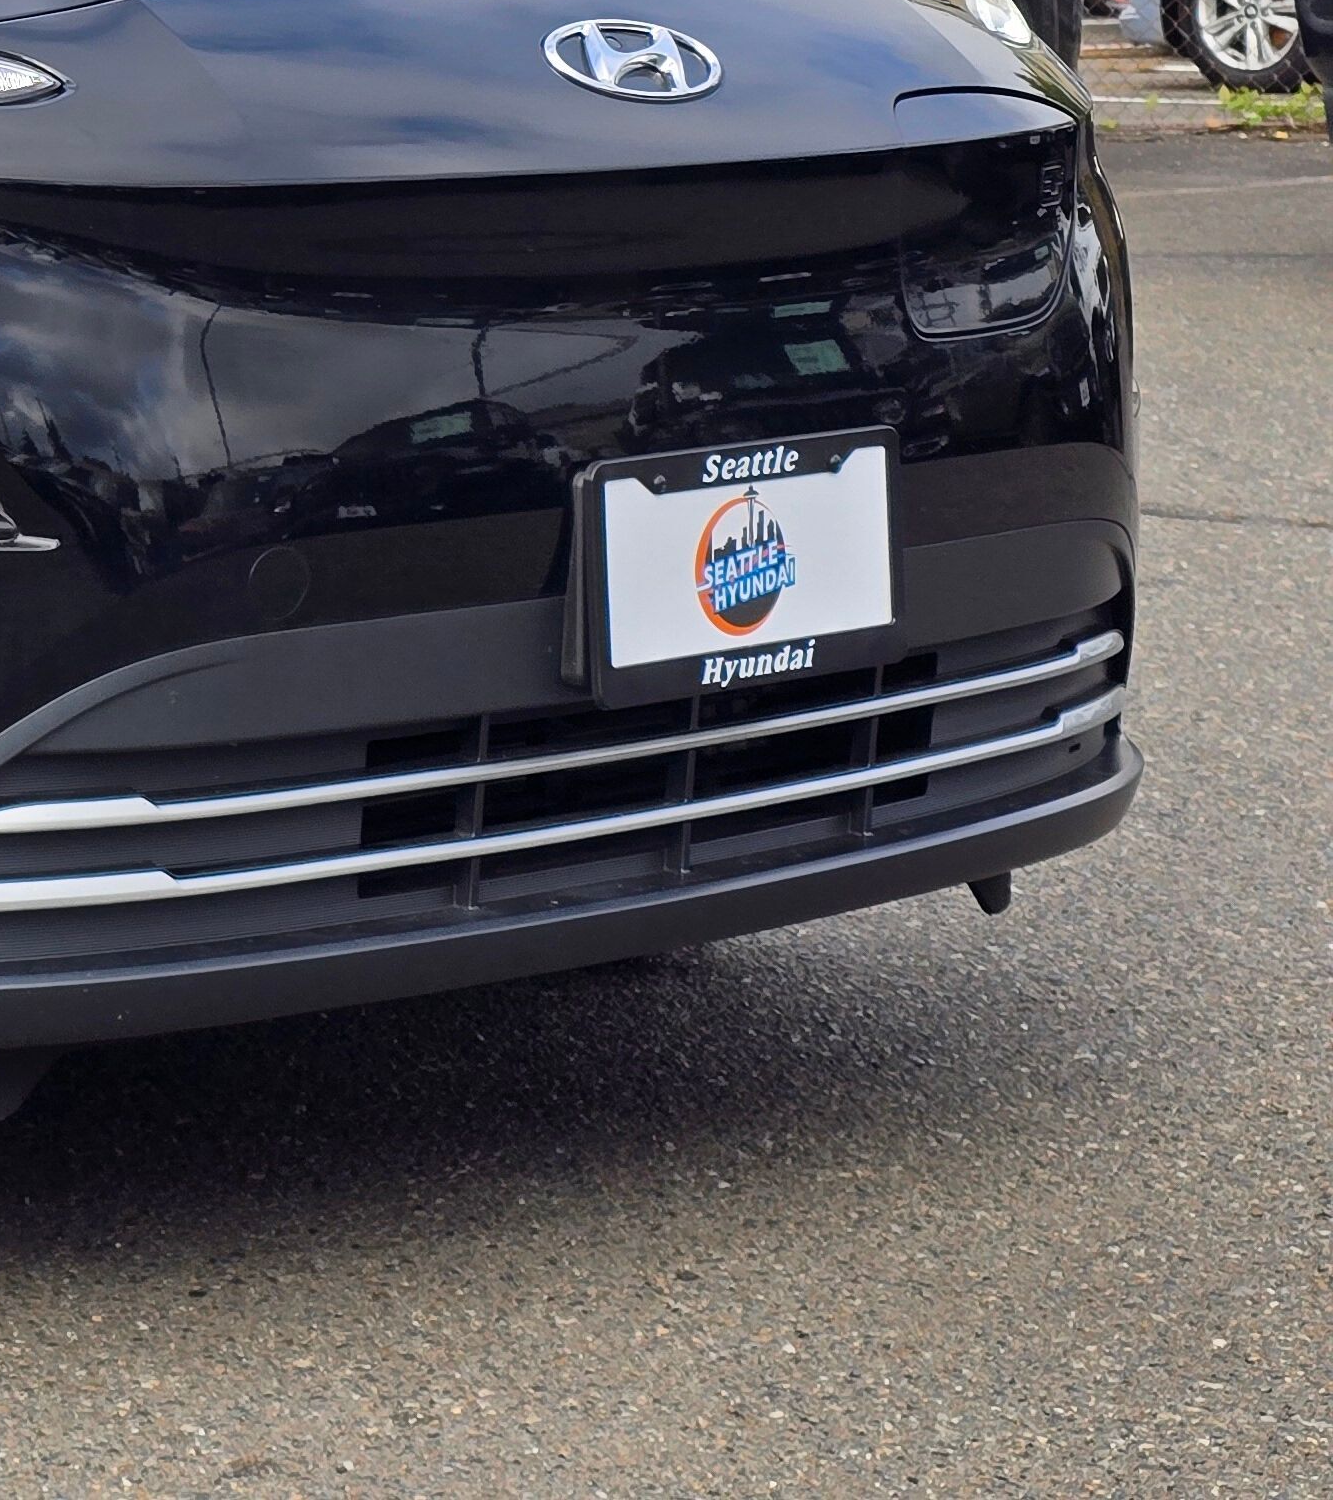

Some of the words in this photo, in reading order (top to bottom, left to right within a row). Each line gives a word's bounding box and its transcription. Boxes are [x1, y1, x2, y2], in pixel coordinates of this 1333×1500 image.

[702, 445, 799, 484] Seattle
[703, 543, 780, 589] SEATTLE
[713, 556, 797, 613] HYUNDAI
[701, 638, 816, 688] Hyundai
